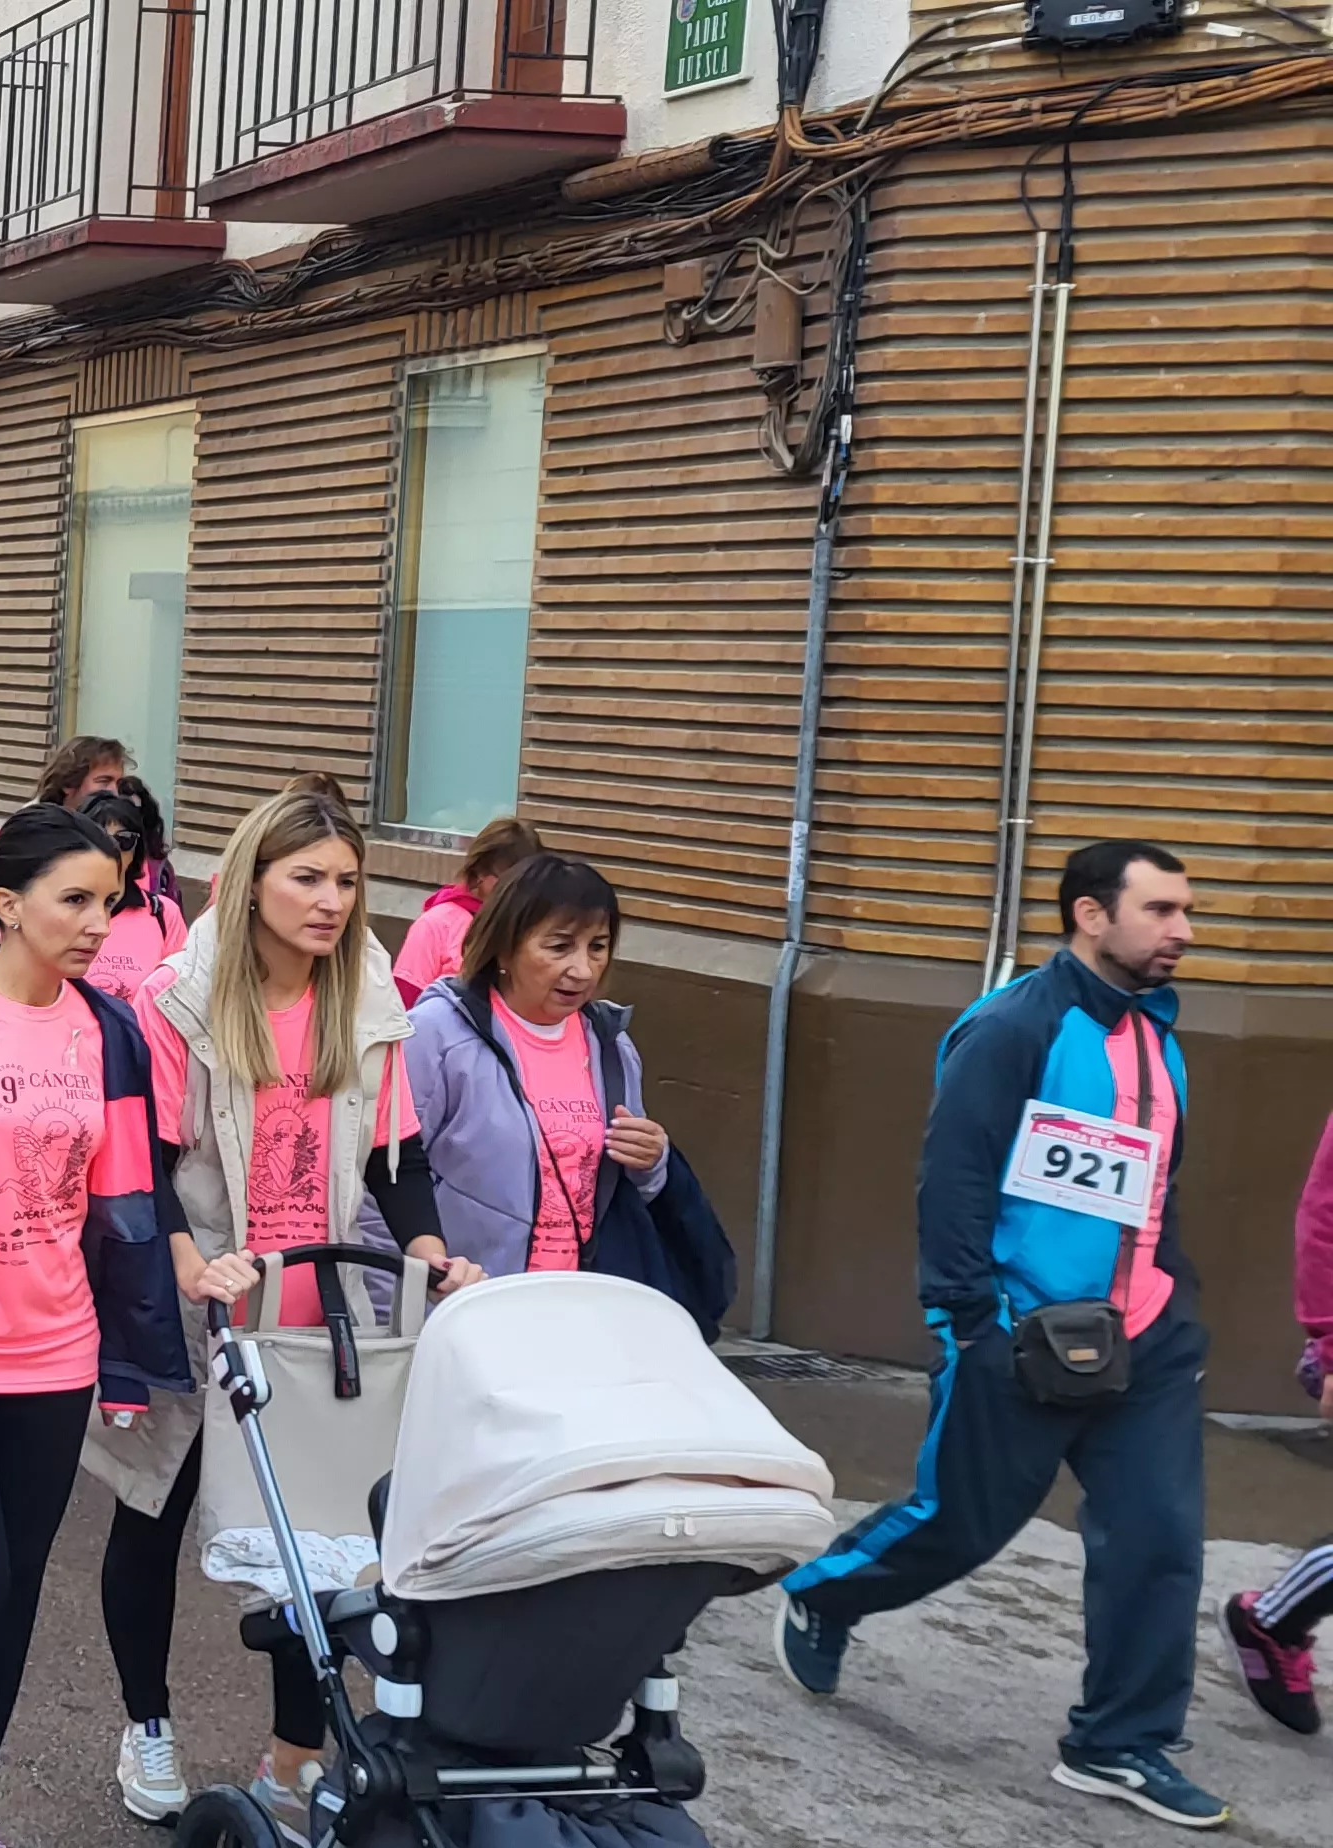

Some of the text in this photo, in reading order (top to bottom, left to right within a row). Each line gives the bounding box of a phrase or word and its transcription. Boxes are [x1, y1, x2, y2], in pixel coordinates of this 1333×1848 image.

[684, 12, 728, 50] PADRE
[677, 46, 728, 84] HUESCA
[96, 954, 134, 964] ÁNCER
[29, 1069, 92, 1090] CÁNCER
[539, 1098, 598, 1114] CÁNCER
[1043, 1144, 1129, 1195] 921
[288, 1203, 326, 1214] MUCHO
